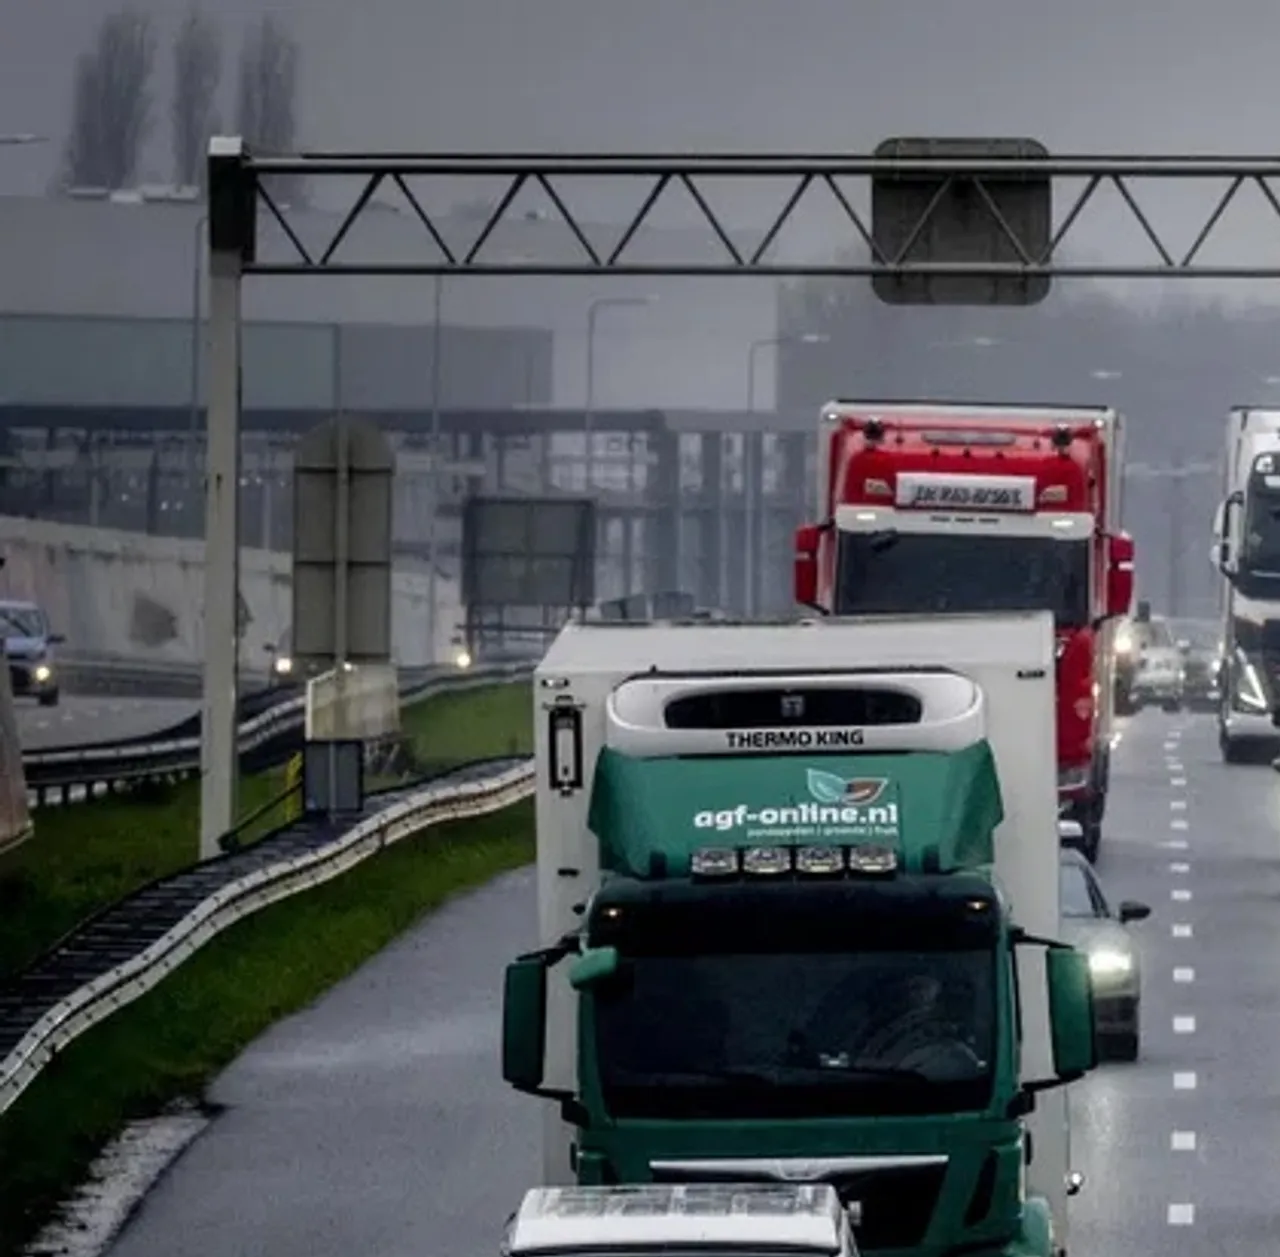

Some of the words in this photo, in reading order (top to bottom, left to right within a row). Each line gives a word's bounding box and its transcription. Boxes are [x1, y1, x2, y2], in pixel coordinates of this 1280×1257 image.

[727, 731, 812, 748] THERMO
[816, 729, 864, 746] KING
[694, 803, 898, 831] agf-online.nl
